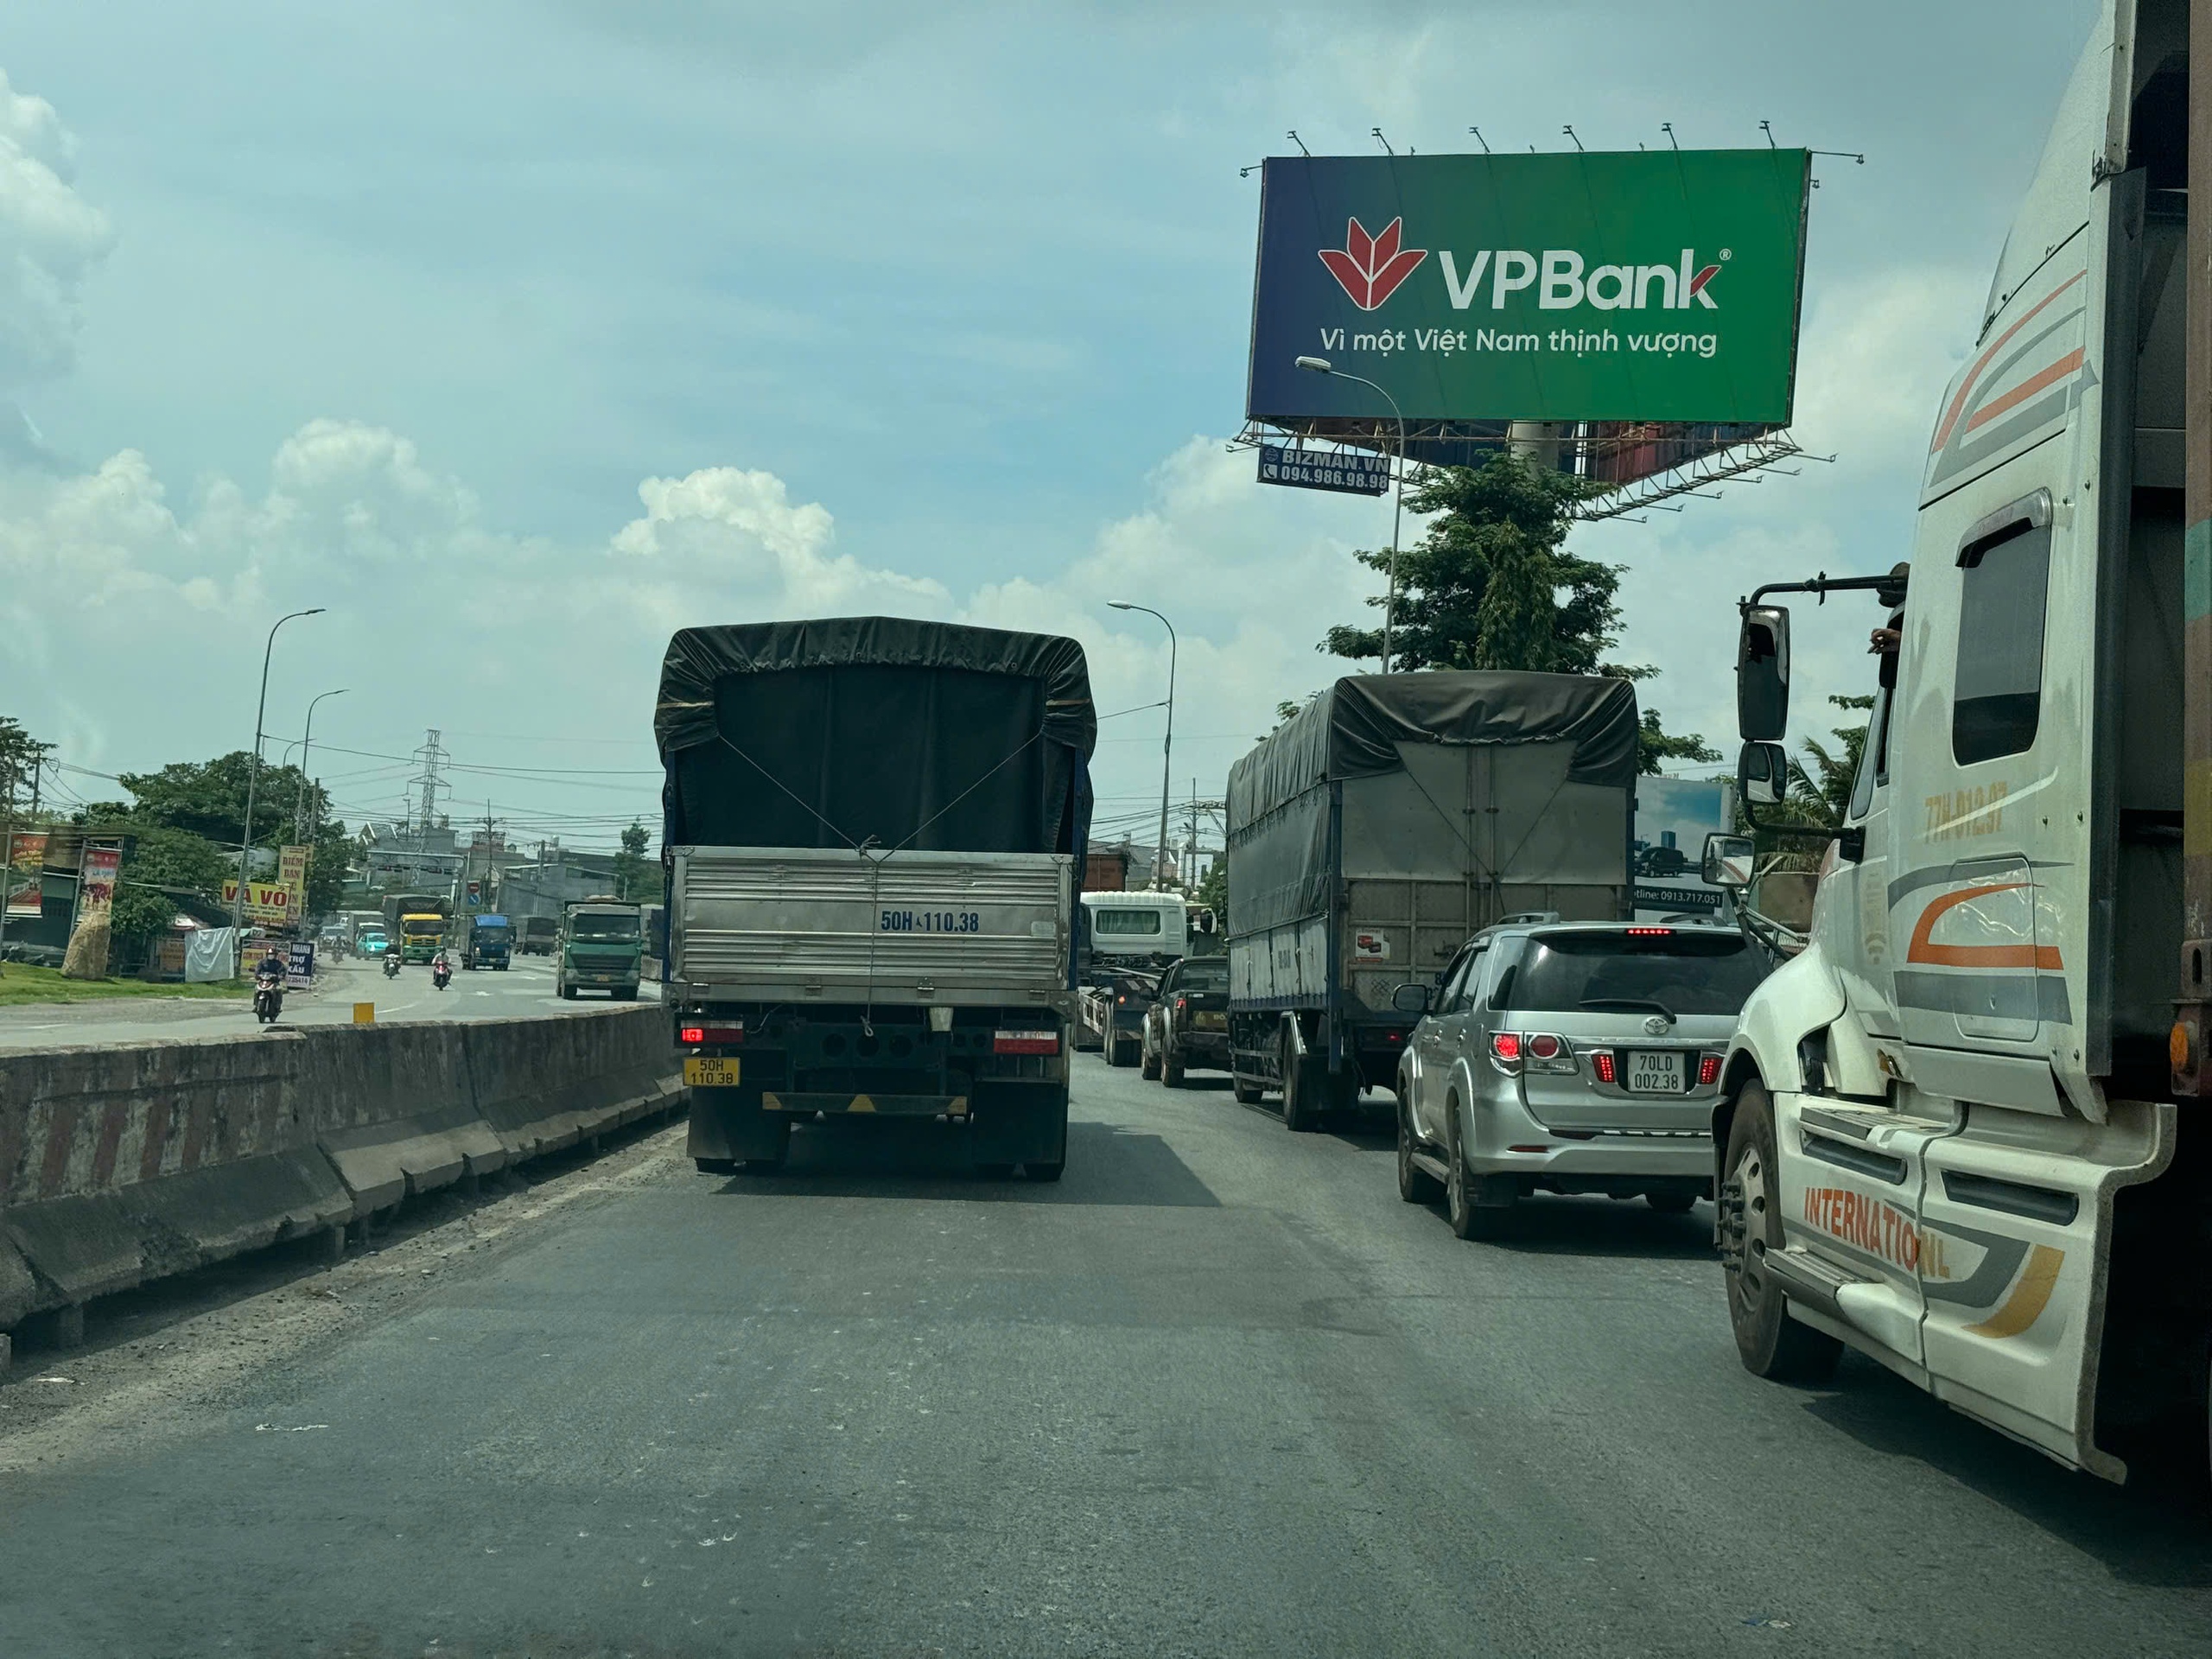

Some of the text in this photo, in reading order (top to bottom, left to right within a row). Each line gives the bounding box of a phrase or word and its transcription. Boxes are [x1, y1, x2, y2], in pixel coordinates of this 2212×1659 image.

[1439, 249, 1722, 310] VPBank
[1319, 328, 1717, 359] Vì một Việt Nam thịnh vượng
[1281, 449, 1389, 474] BIZMAN.VN
[1281, 465, 1388, 490] 094.986.98.98
[1661, 891, 1721, 906] 0913.717.051
[700, 1059, 723, 1071] 50H
[1640, 1055, 1673, 1071] 70LD
[690, 1072, 734, 1084] 110.38
[1635, 1073, 1679, 1090] 002.38
